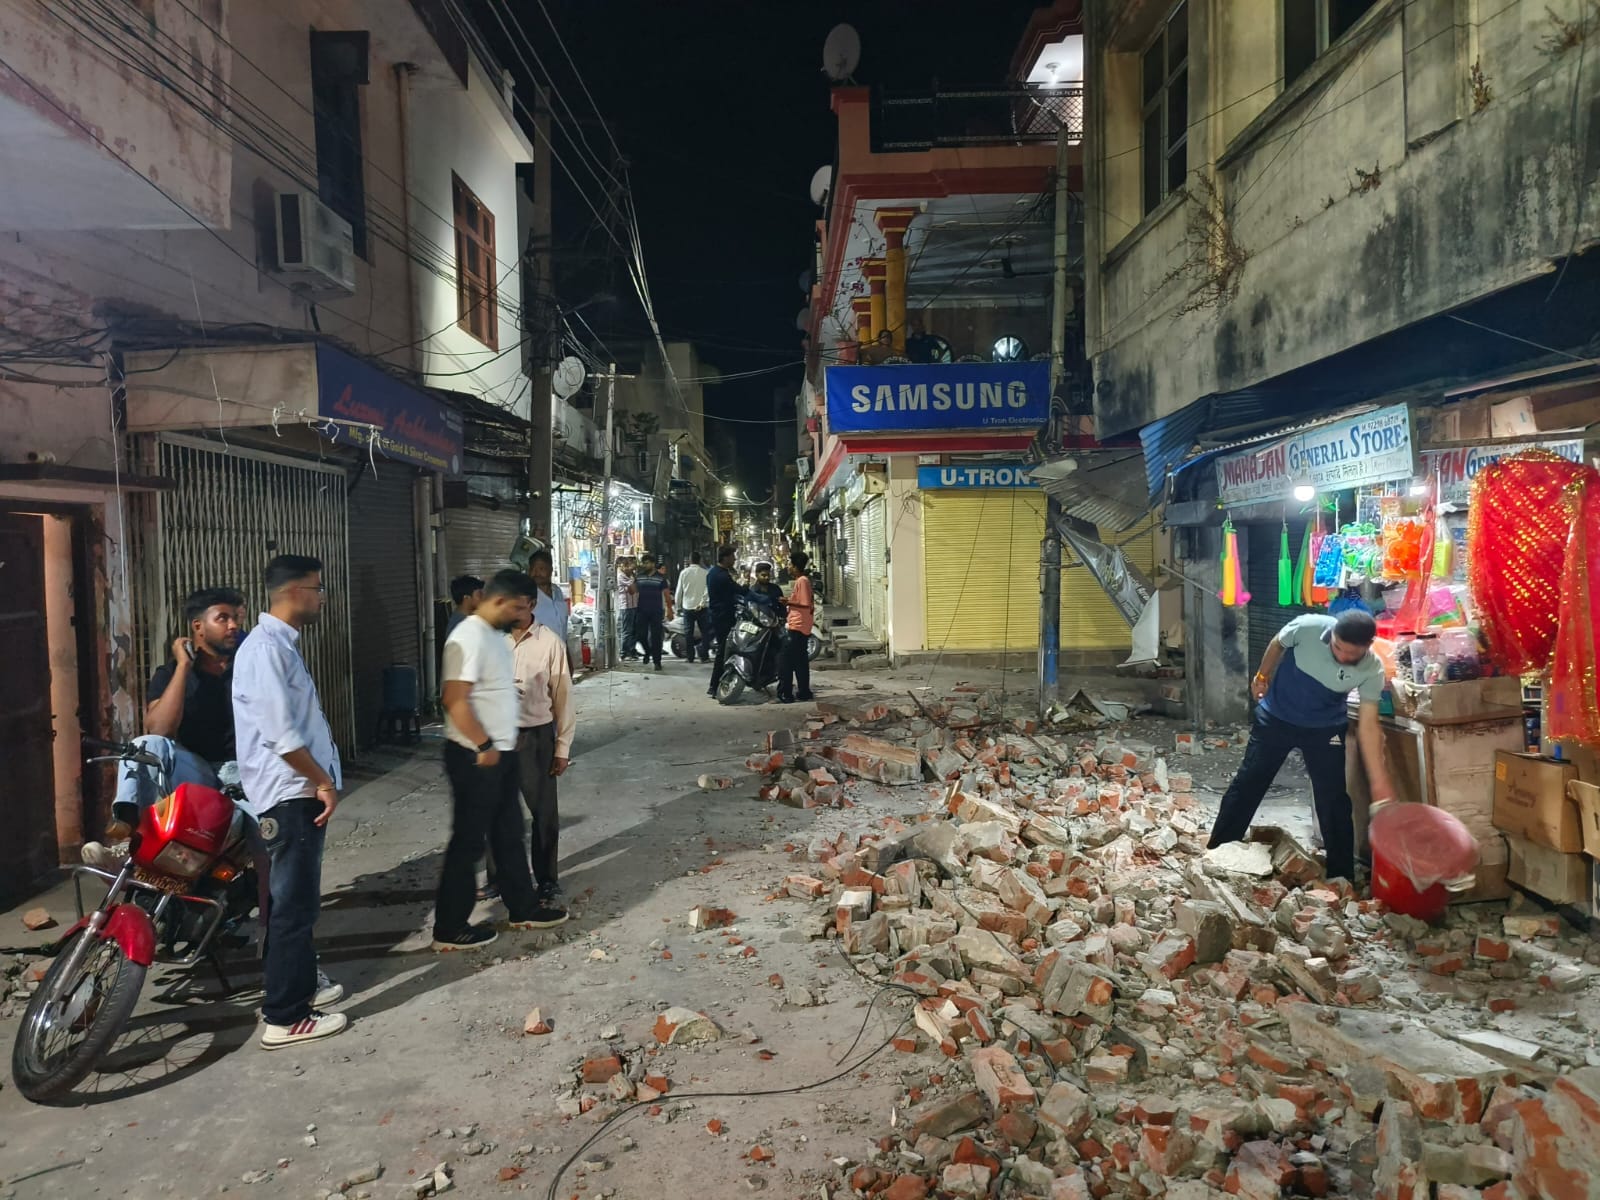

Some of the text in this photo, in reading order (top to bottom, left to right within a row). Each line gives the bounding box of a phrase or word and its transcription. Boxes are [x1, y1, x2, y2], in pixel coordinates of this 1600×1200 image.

[851, 380, 1027, 414] SAMSUNG
[1223, 445, 1286, 490] MAHAJAN
[1289, 439, 1348, 471] GENERAL
[1350, 423, 1403, 458] STORE
